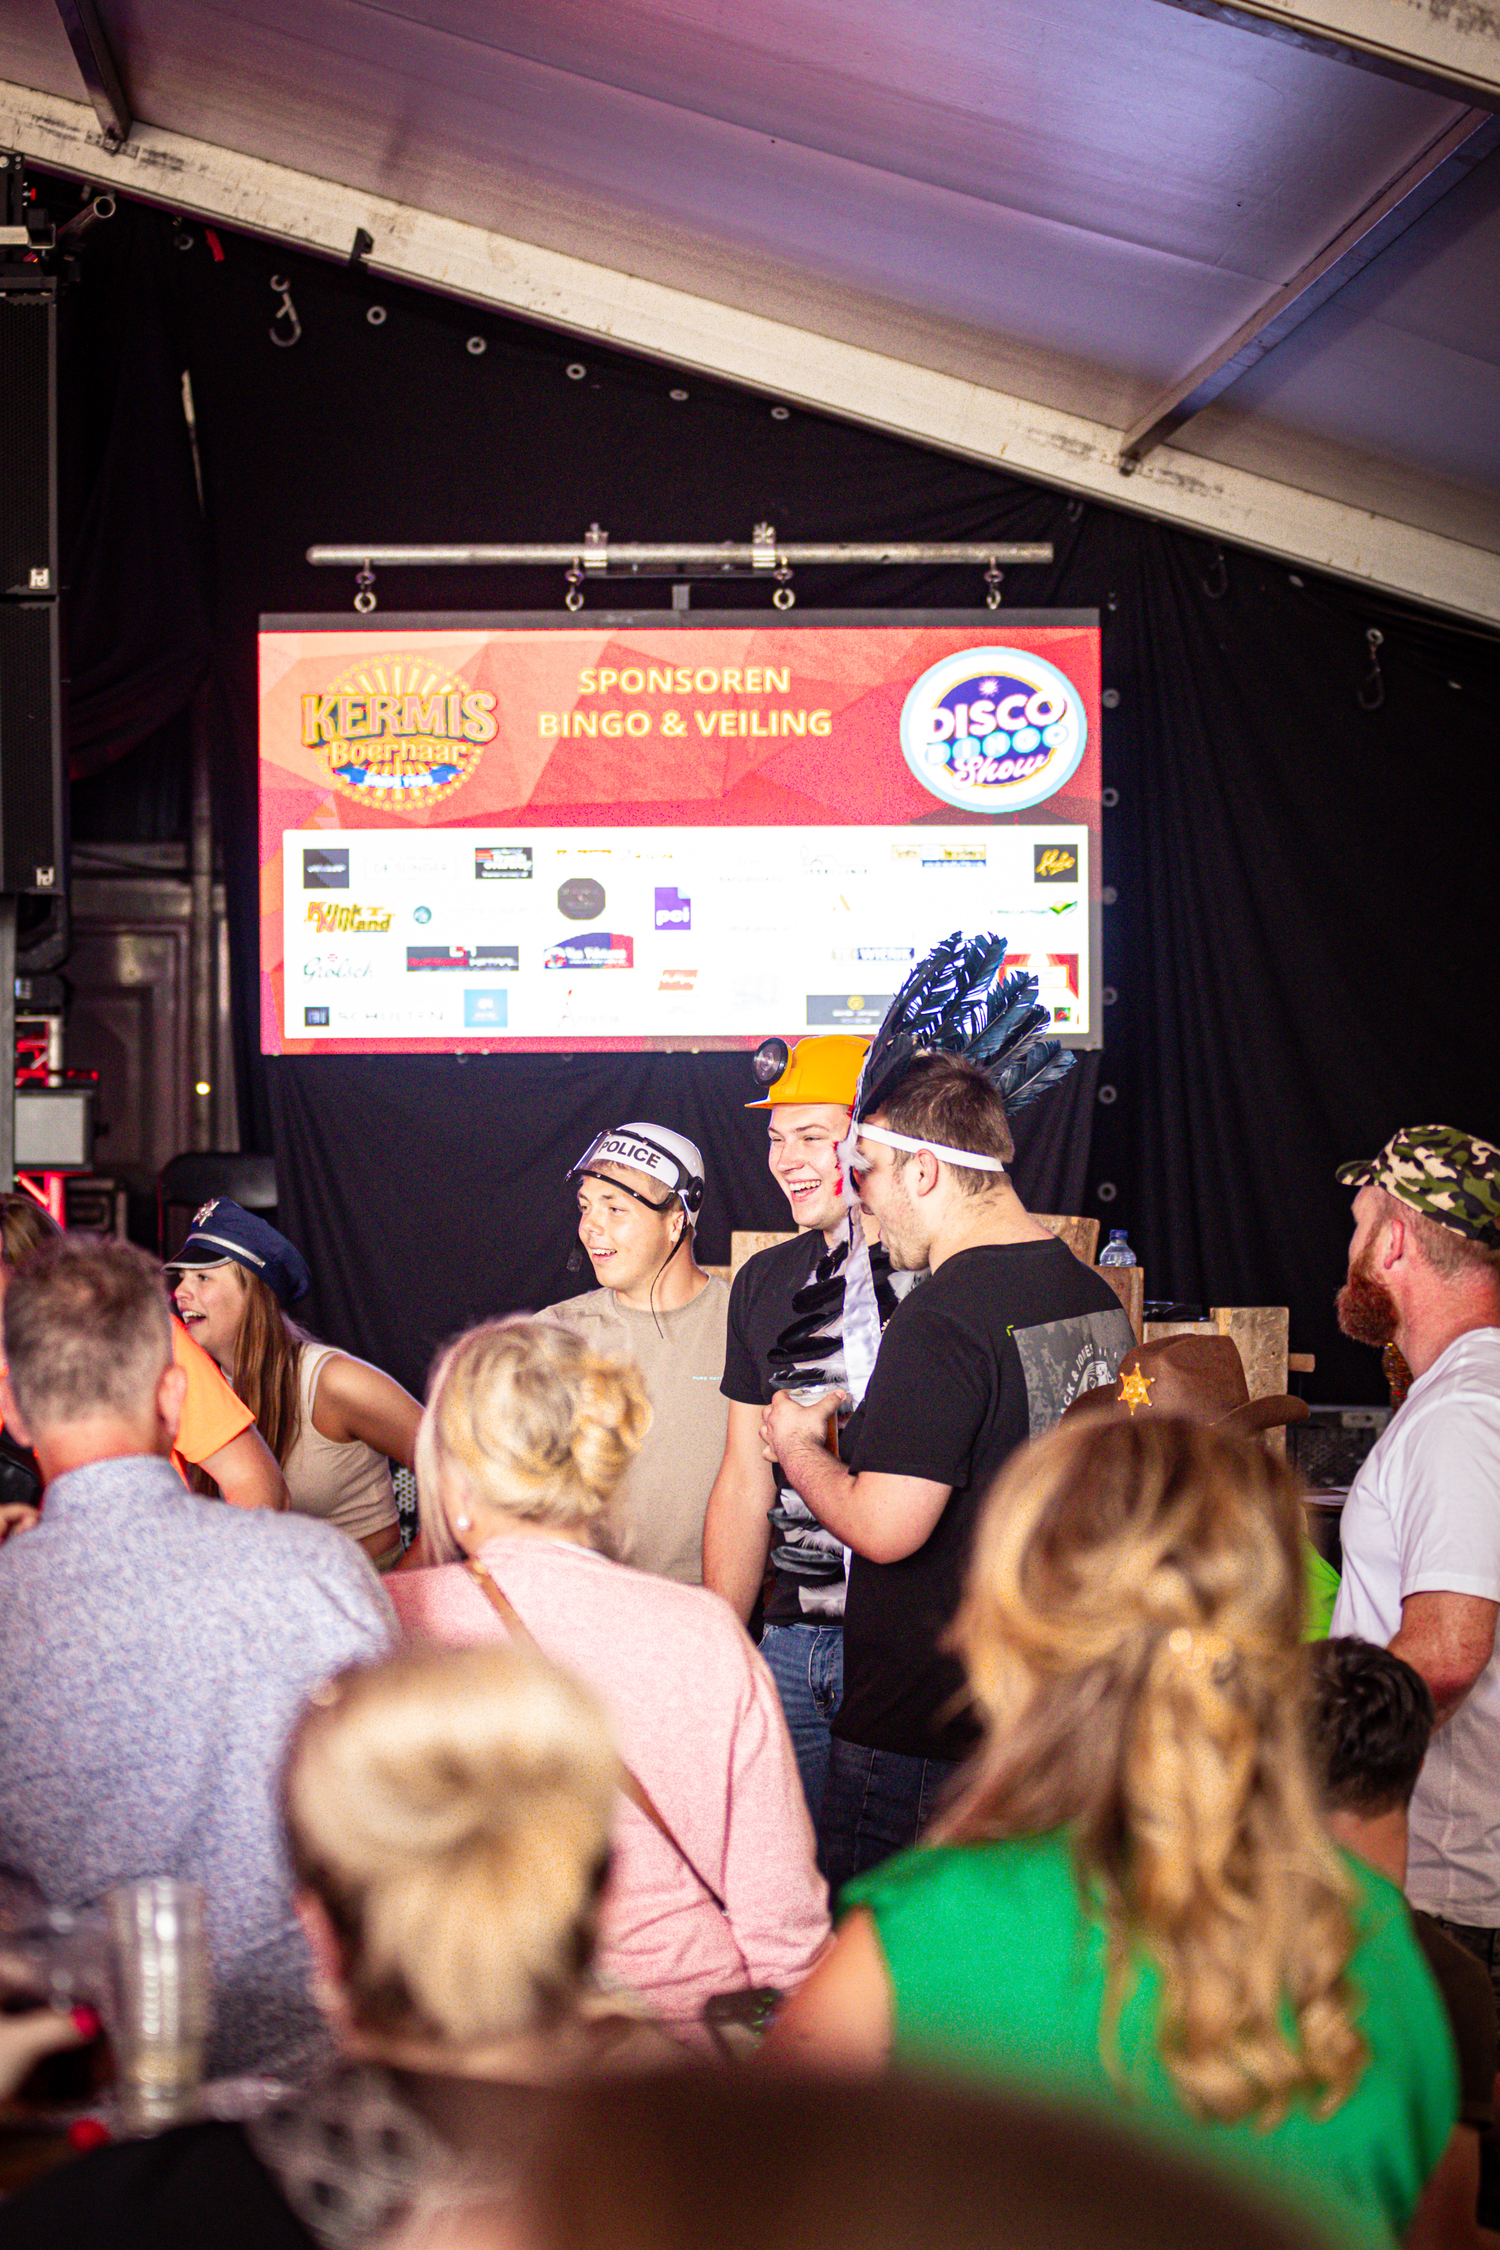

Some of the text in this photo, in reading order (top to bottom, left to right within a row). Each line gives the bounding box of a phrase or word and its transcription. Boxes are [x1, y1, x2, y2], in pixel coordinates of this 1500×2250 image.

[578, 667, 790, 694] SPONSOREN
[303, 692, 498, 747] KERMIS
[538, 709, 832, 738] BINGO & VEILING
[927, 691, 1065, 746] DISCO
[330, 738, 469, 768] Boerhaar
[926, 722, 1069, 765] BINGO
[952, 755, 1049, 790] Show
[599, 1140, 661, 1169] POLICE
